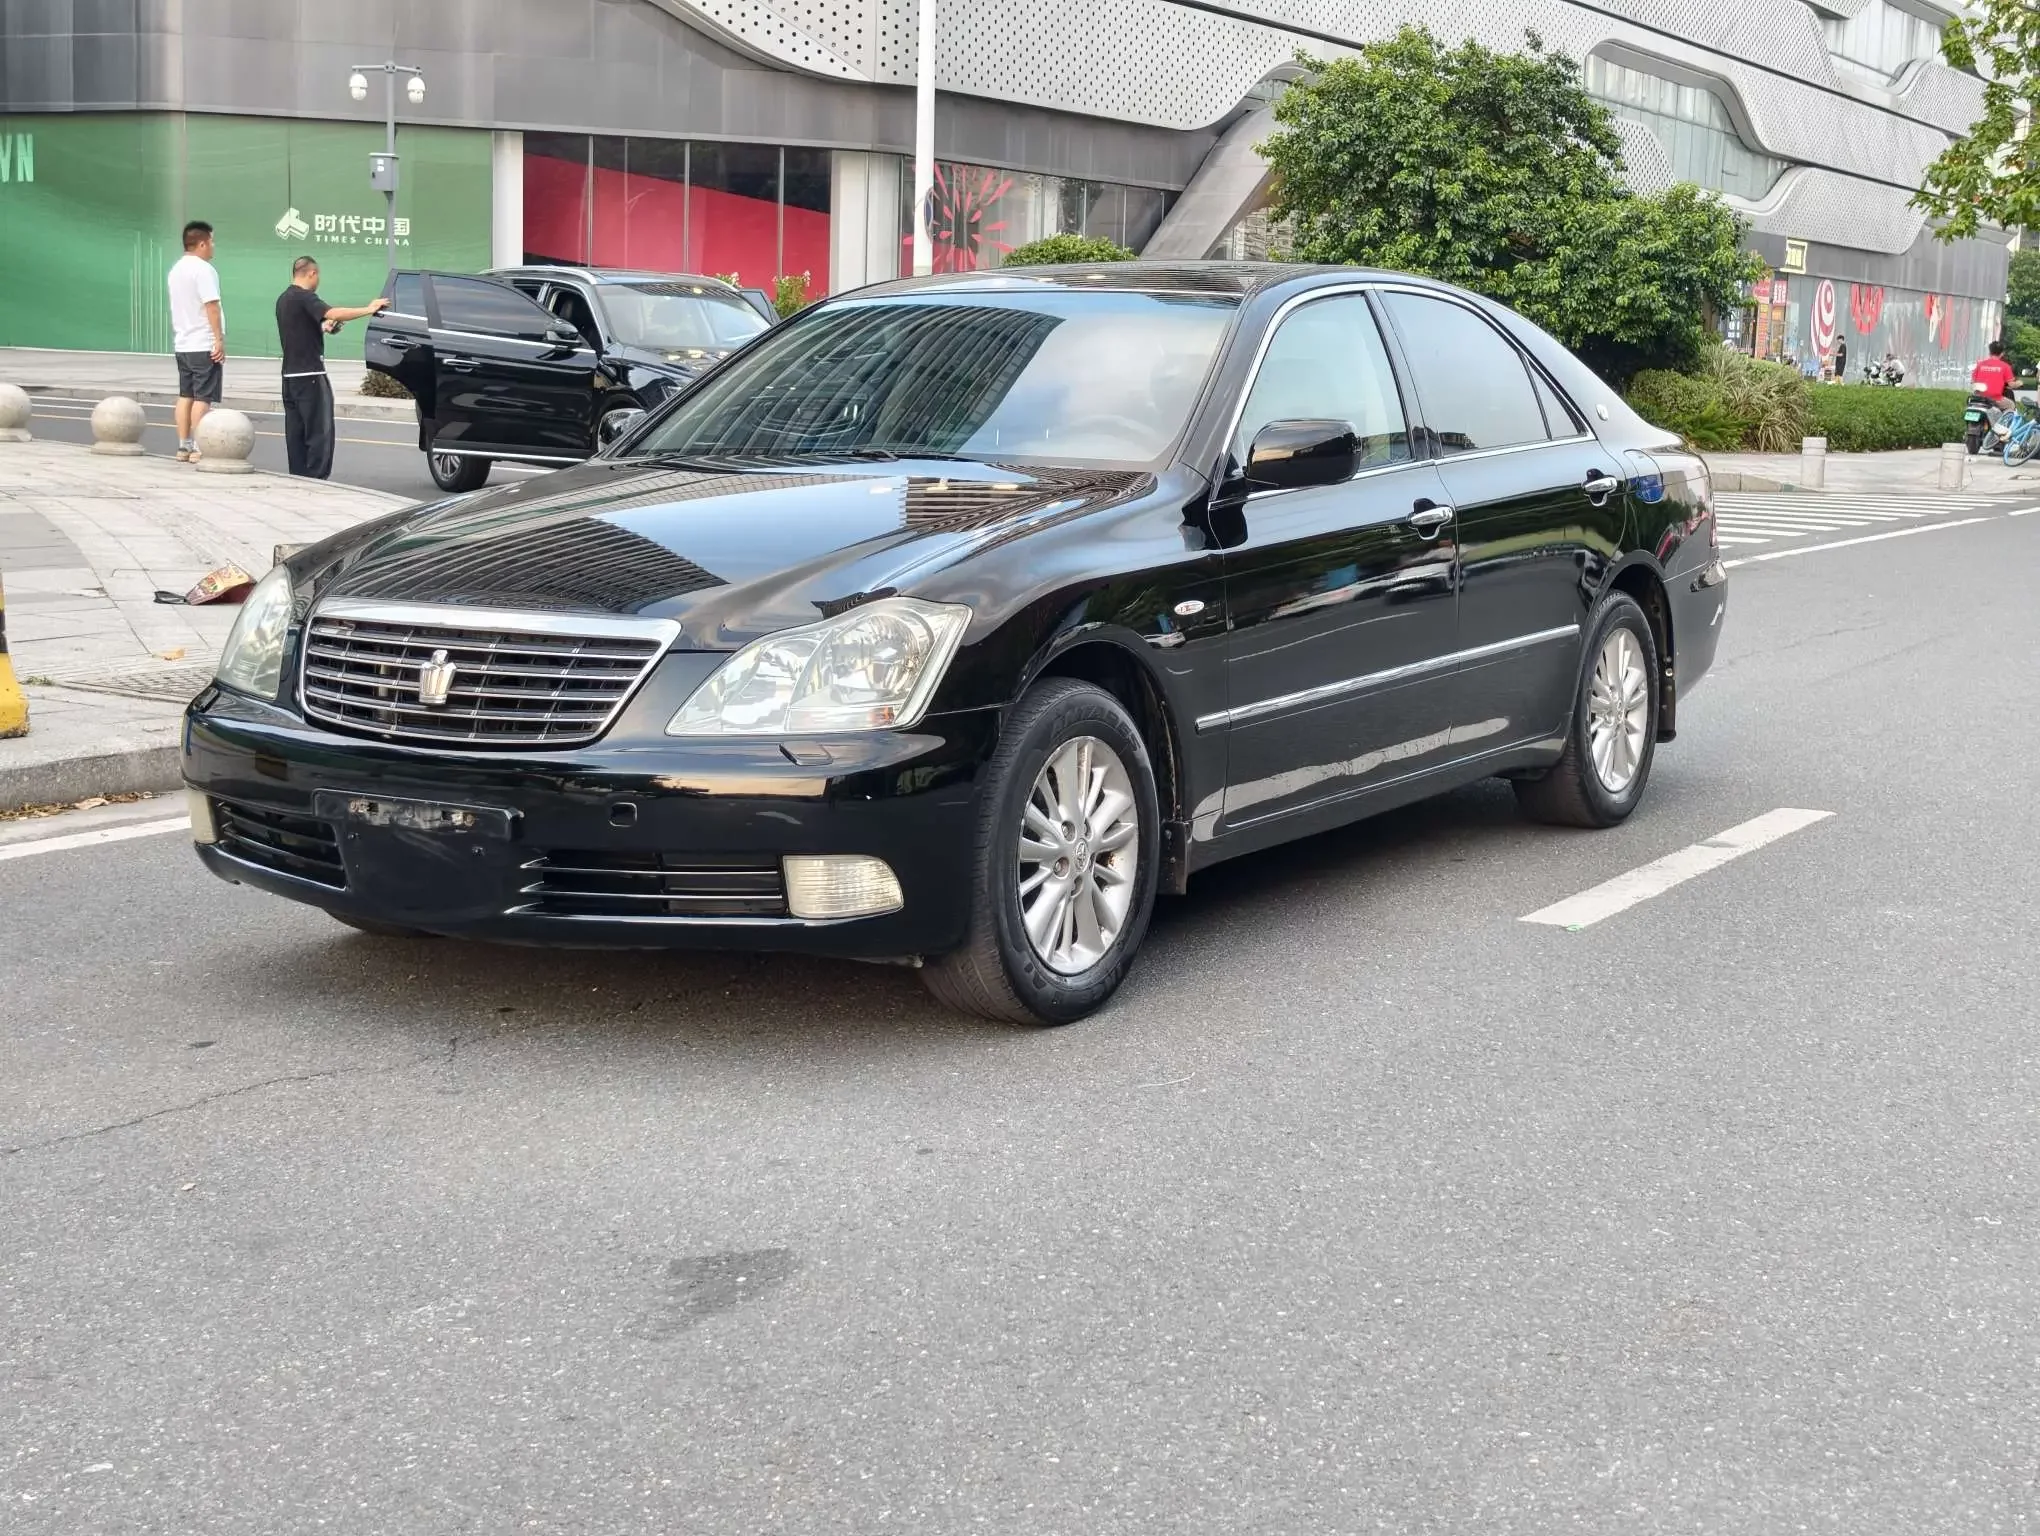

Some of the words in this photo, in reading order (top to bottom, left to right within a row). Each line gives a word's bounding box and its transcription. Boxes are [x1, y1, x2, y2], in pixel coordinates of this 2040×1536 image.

[314, 214, 410, 236] 时代中国
[315, 234, 357, 244] TIMES
